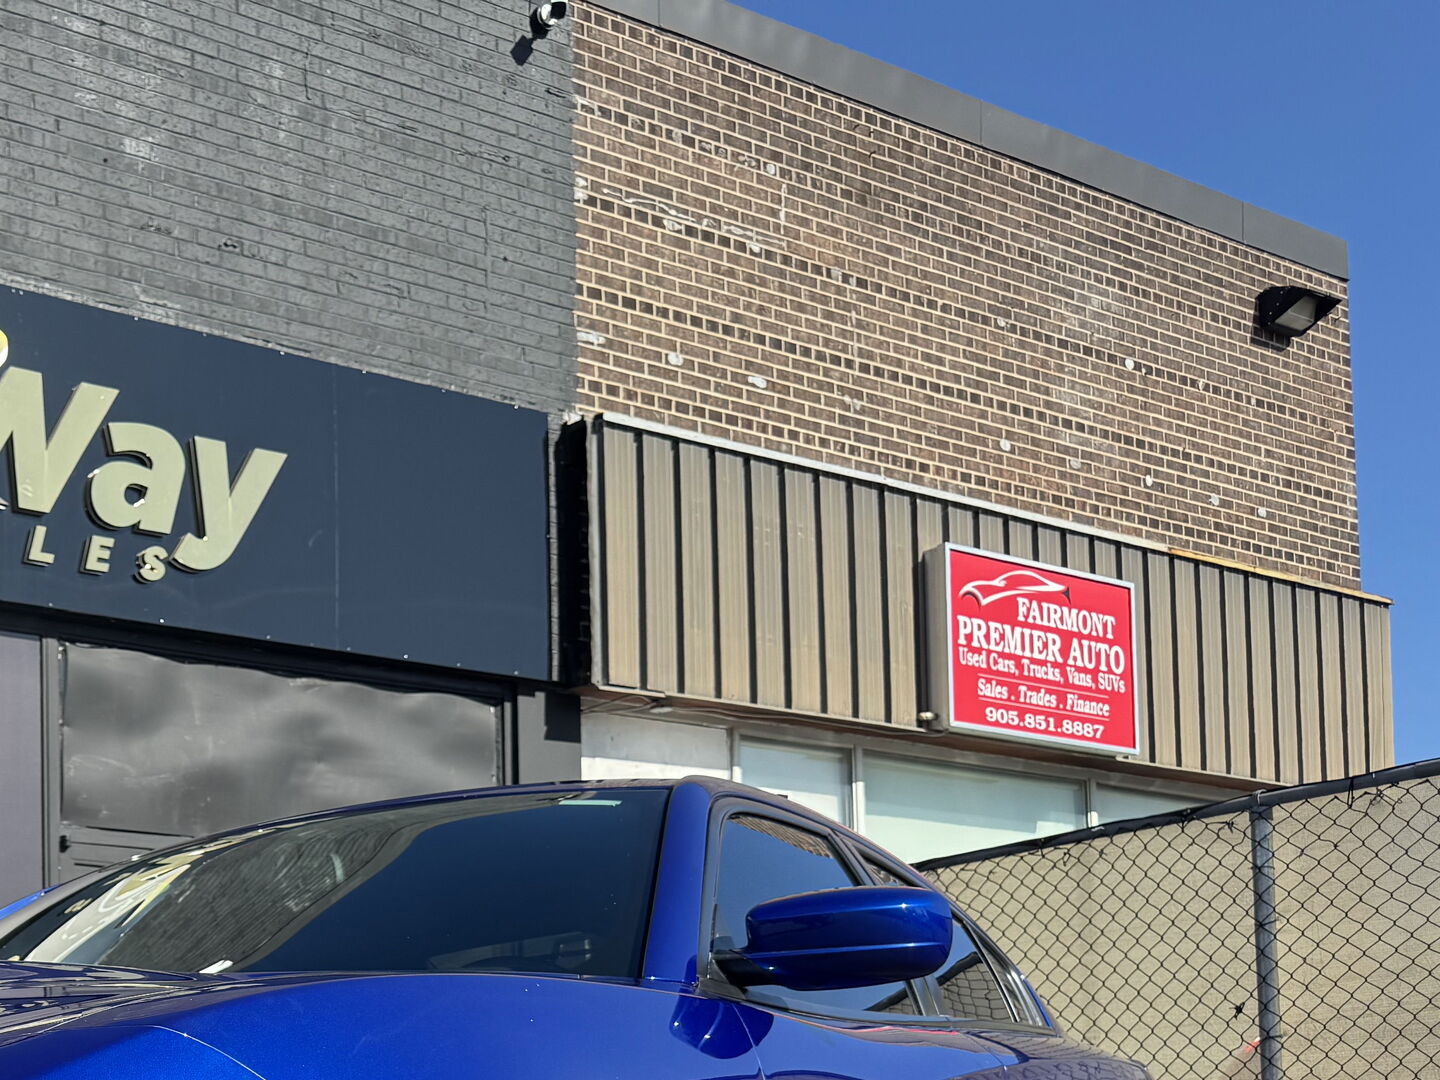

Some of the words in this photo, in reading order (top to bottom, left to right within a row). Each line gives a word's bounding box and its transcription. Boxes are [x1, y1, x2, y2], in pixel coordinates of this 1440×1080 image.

[1016, 597, 1116, 639] FAIRMONT
[956, 615, 1063, 663] PREMIER
[1067, 637, 1125, 675] AUTO
[958, 646, 987, 668] Used
[989, 653, 1019, 676] Cars,
[1021, 658, 1064, 684] Trucks,
[1066, 666, 1096, 690] Vans,
[1098, 672, 1126, 694] SUVs
[977, 678, 1009, 700] Sales
[1018, 685, 1057, 708] Trades
[1066, 693, 1110, 717] Finance
[985, 706, 1105, 739] 905.851.8887
